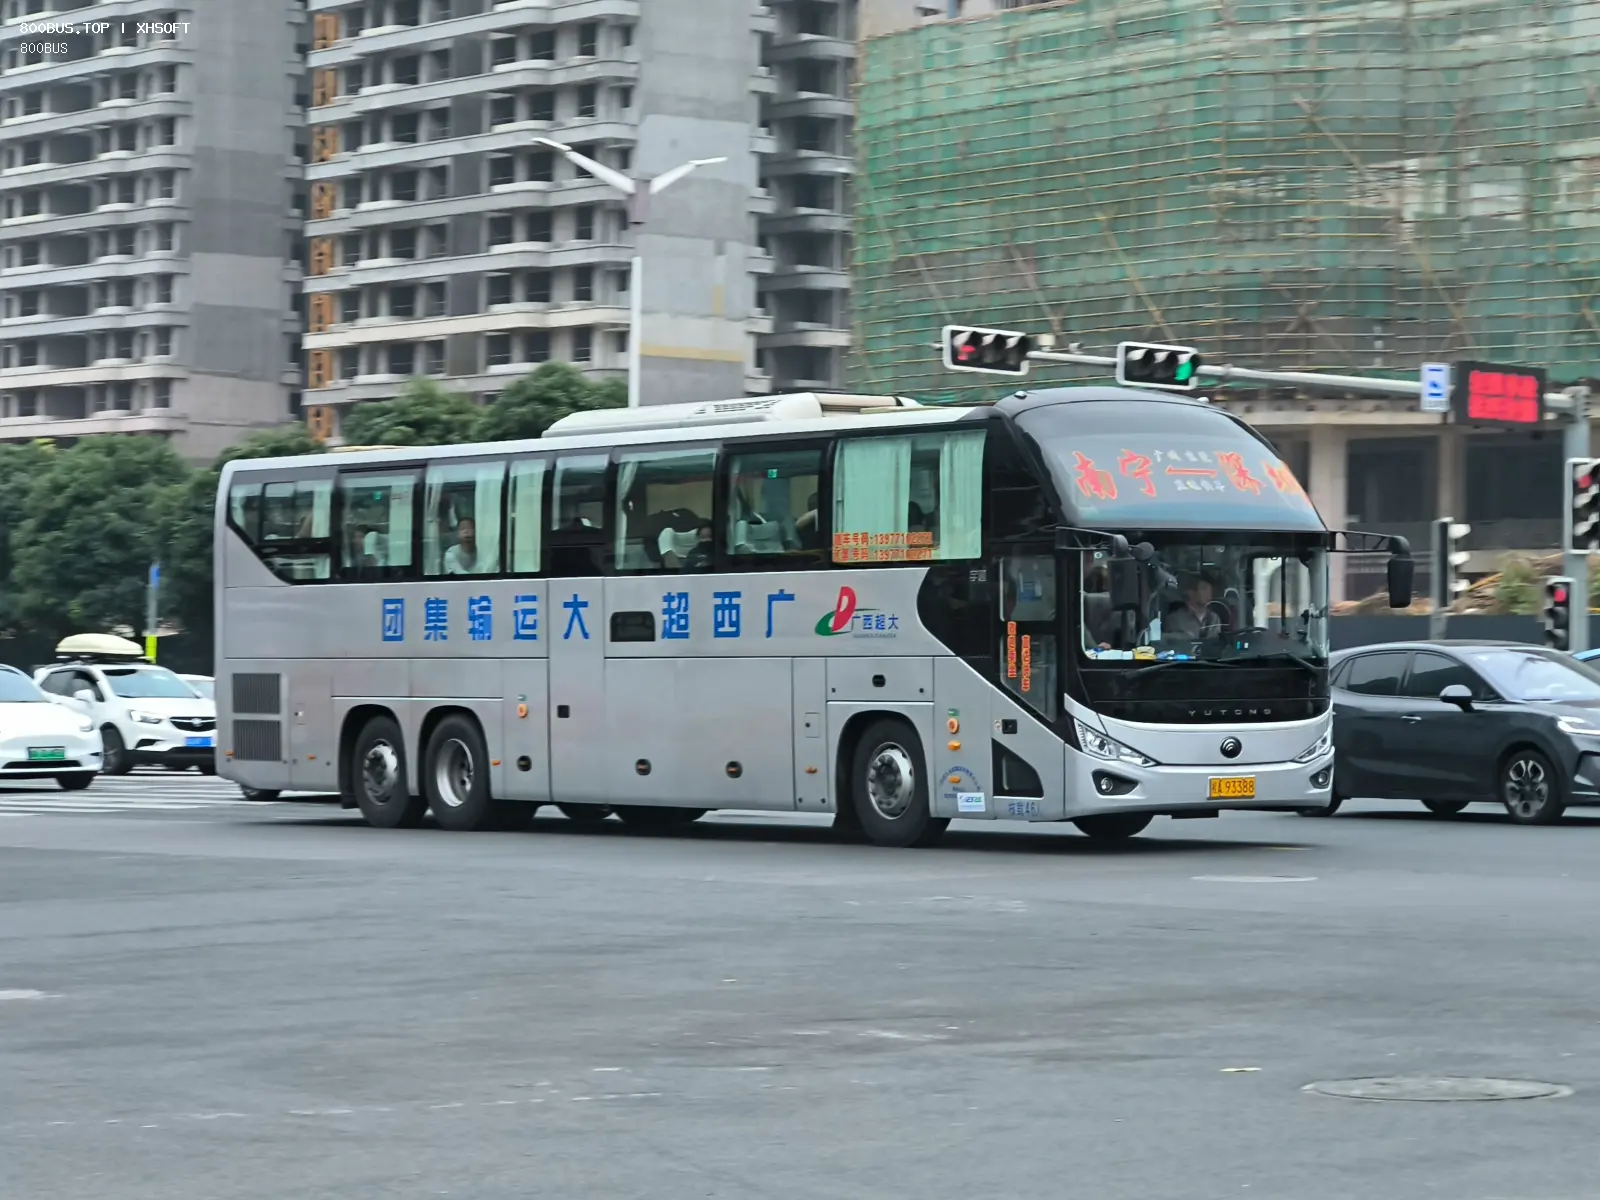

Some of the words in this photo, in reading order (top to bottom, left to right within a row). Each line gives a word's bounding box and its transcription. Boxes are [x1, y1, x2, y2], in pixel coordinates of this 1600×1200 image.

[1072, 449, 1157, 500] 南宁
[851, 613, 899, 631] 广西超大
